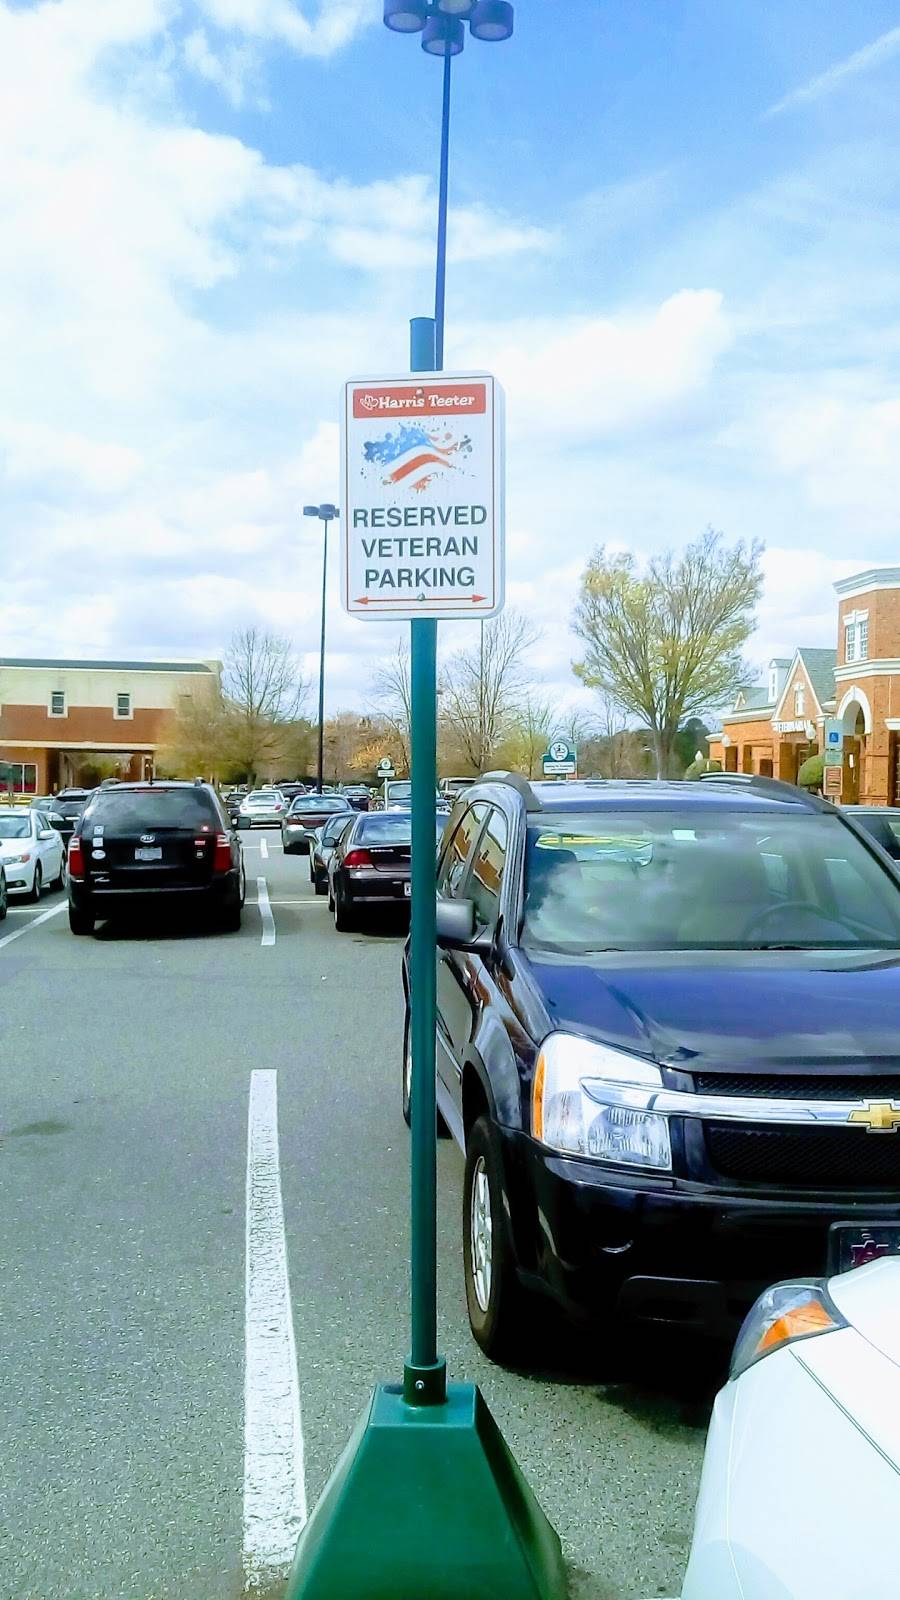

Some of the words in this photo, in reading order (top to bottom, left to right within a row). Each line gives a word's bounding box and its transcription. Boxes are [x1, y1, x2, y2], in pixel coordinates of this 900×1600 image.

[378, 396, 425, 408] Harris
[428, 394, 475, 406] Teeter
[353, 505, 487, 528] RESERVED
[362, 536, 478, 558] VETERAN
[365, 567, 475, 588] PARKING
